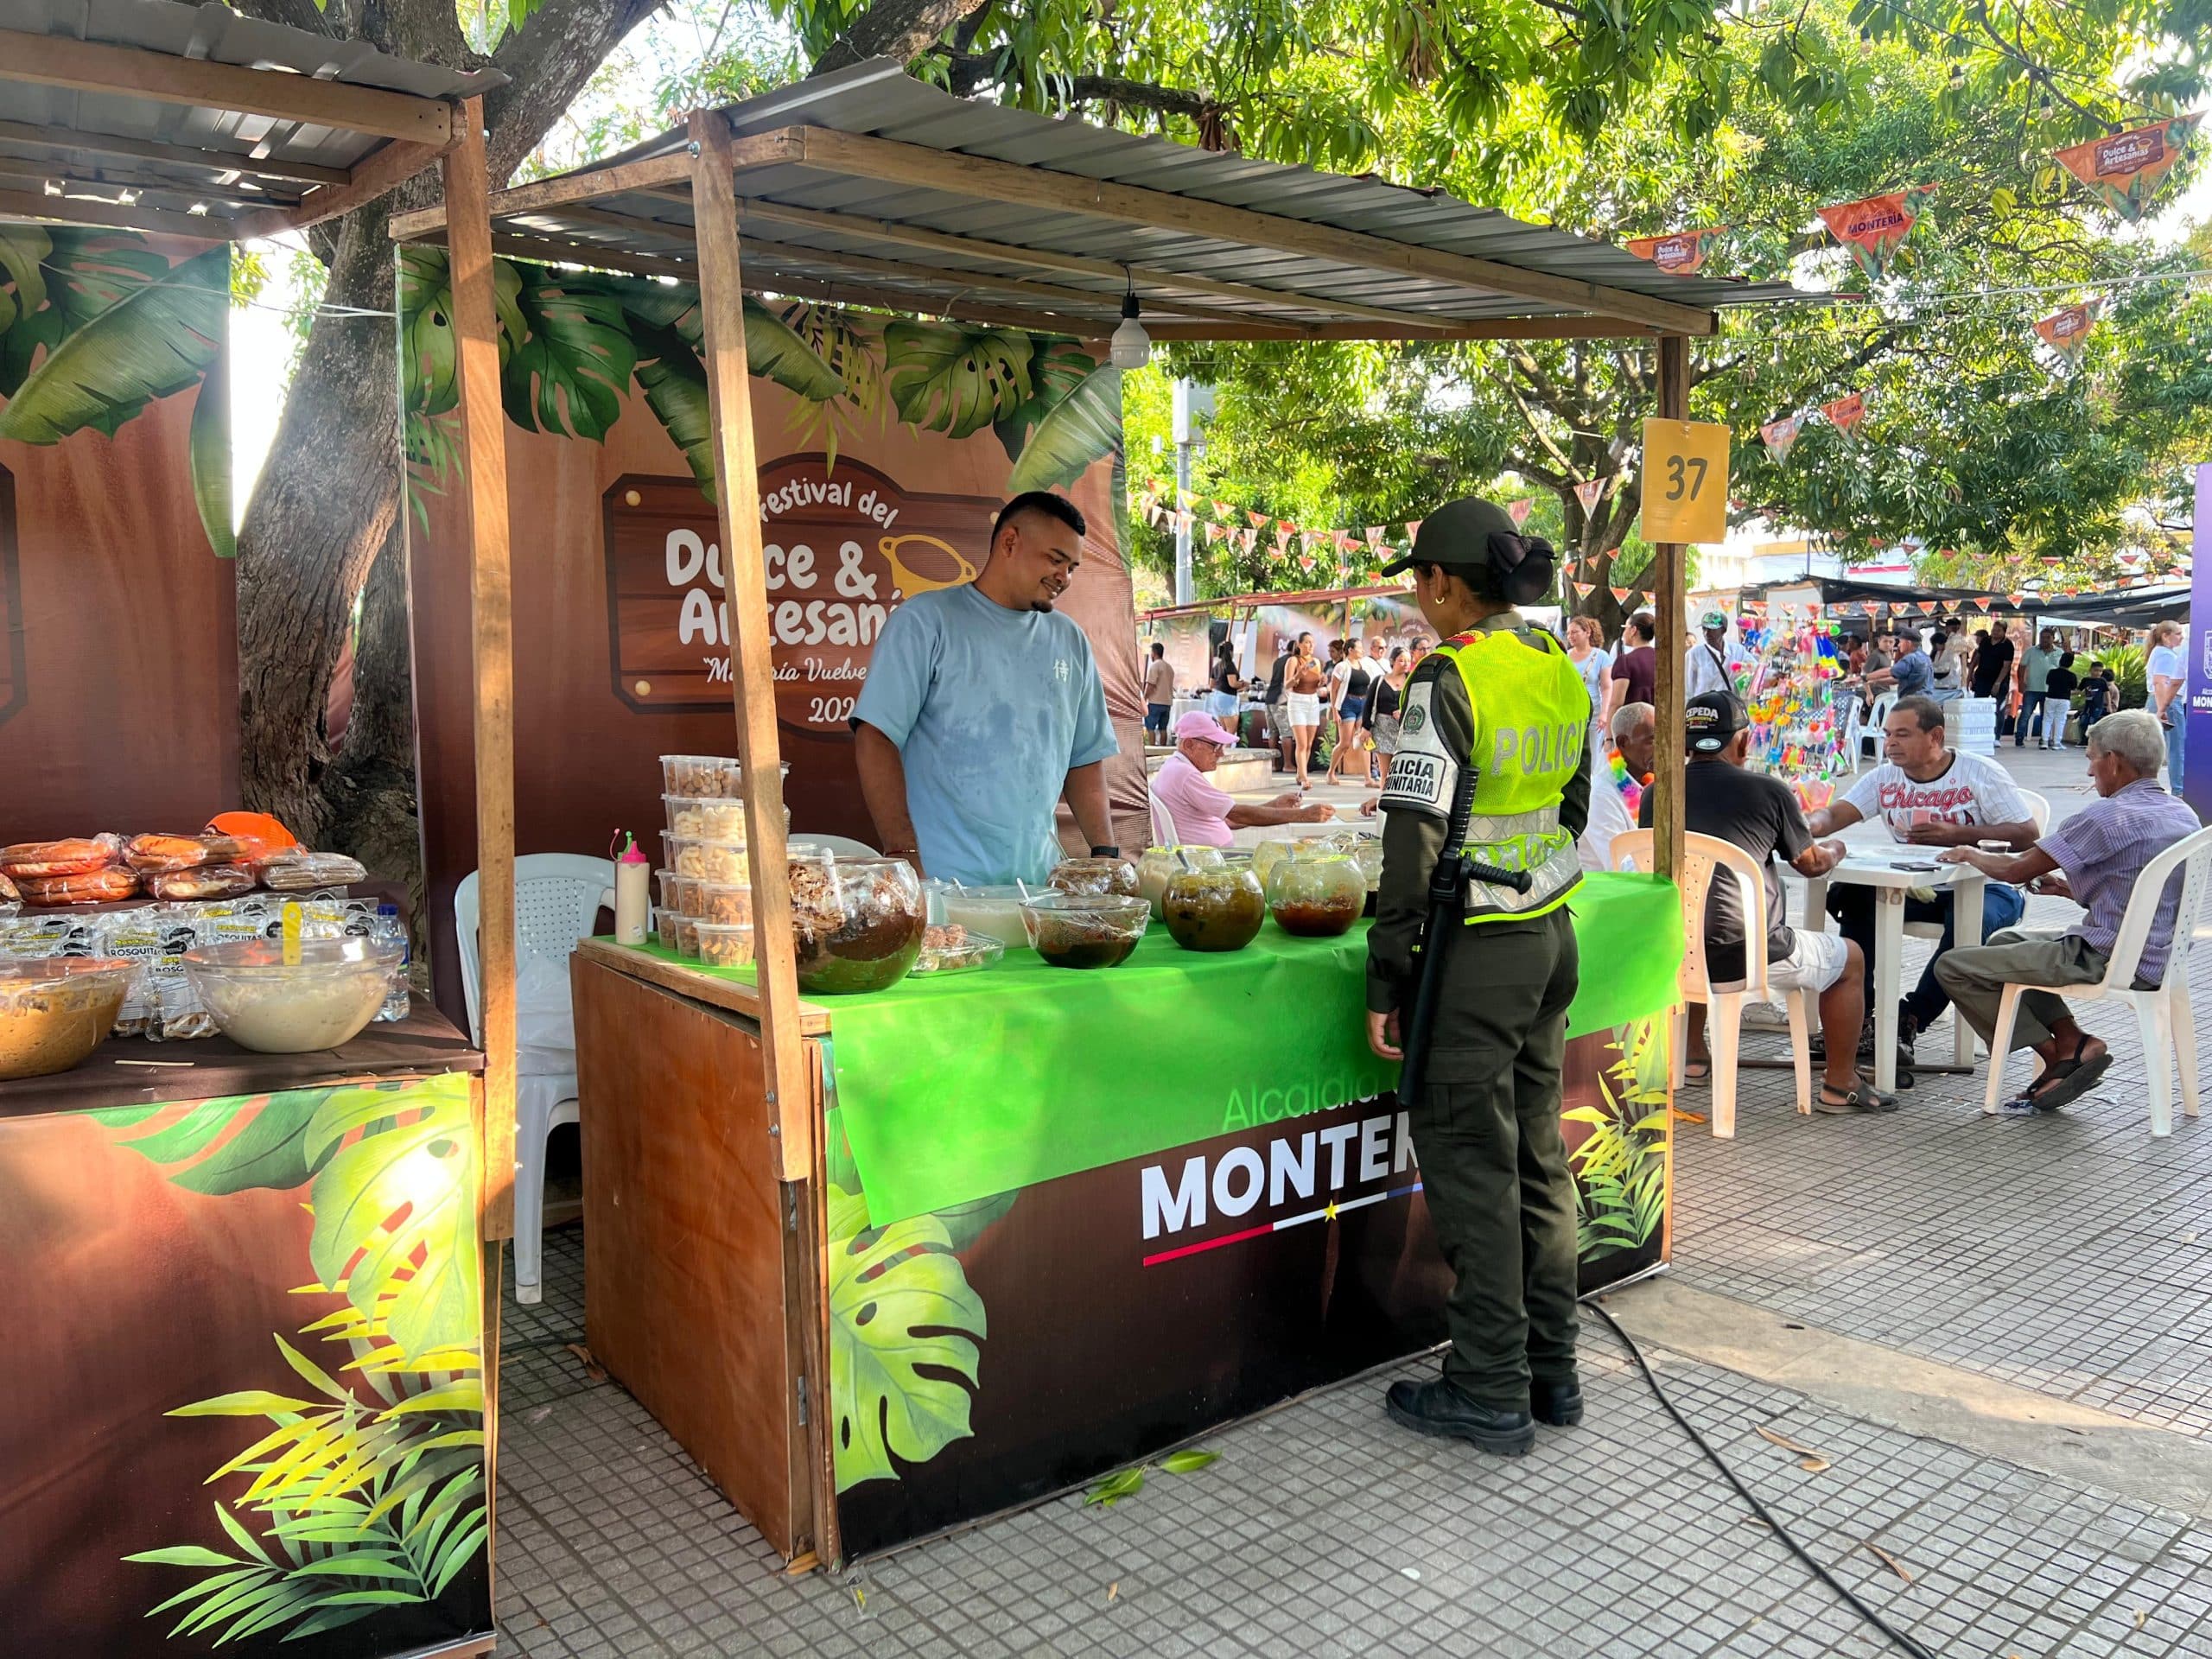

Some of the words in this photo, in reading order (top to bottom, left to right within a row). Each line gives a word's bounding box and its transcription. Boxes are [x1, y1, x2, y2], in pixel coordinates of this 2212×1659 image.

[1666, 454, 1708, 502] 37
[858, 490, 899, 529] del
[666, 529, 818, 590] Duce
[834, 541, 877, 601] &
[679, 588, 901, 647] Aesan
[804, 657, 868, 683] Vuelve
[1686, 706, 1719, 720] CEPEDA
[2192, 695, 2212, 708] MON
[1491, 719, 1588, 776] POLICI
[1384, 776, 1433, 797] UNITARIA
[1879, 781, 1975, 812] Chicago
